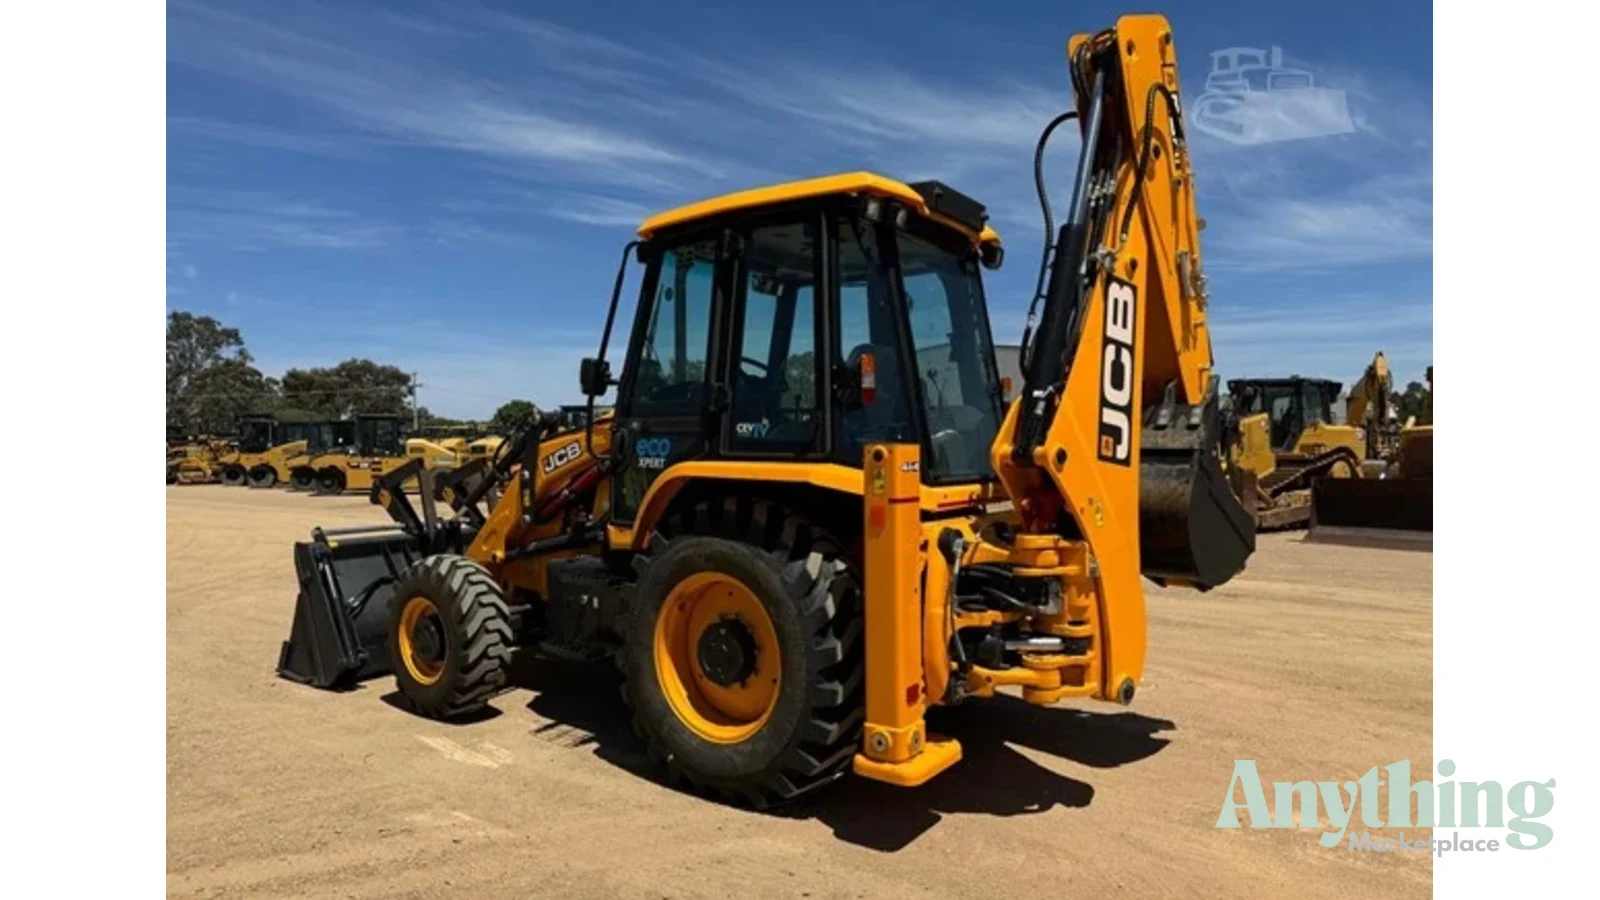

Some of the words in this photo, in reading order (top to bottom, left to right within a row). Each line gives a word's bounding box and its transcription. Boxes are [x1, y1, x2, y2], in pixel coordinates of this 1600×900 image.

[1101, 281, 1135, 460] JCB
[544, 442, 581, 472] JCB
[636, 438, 670, 456] eco
[638, 457, 665, 468] XPERT
